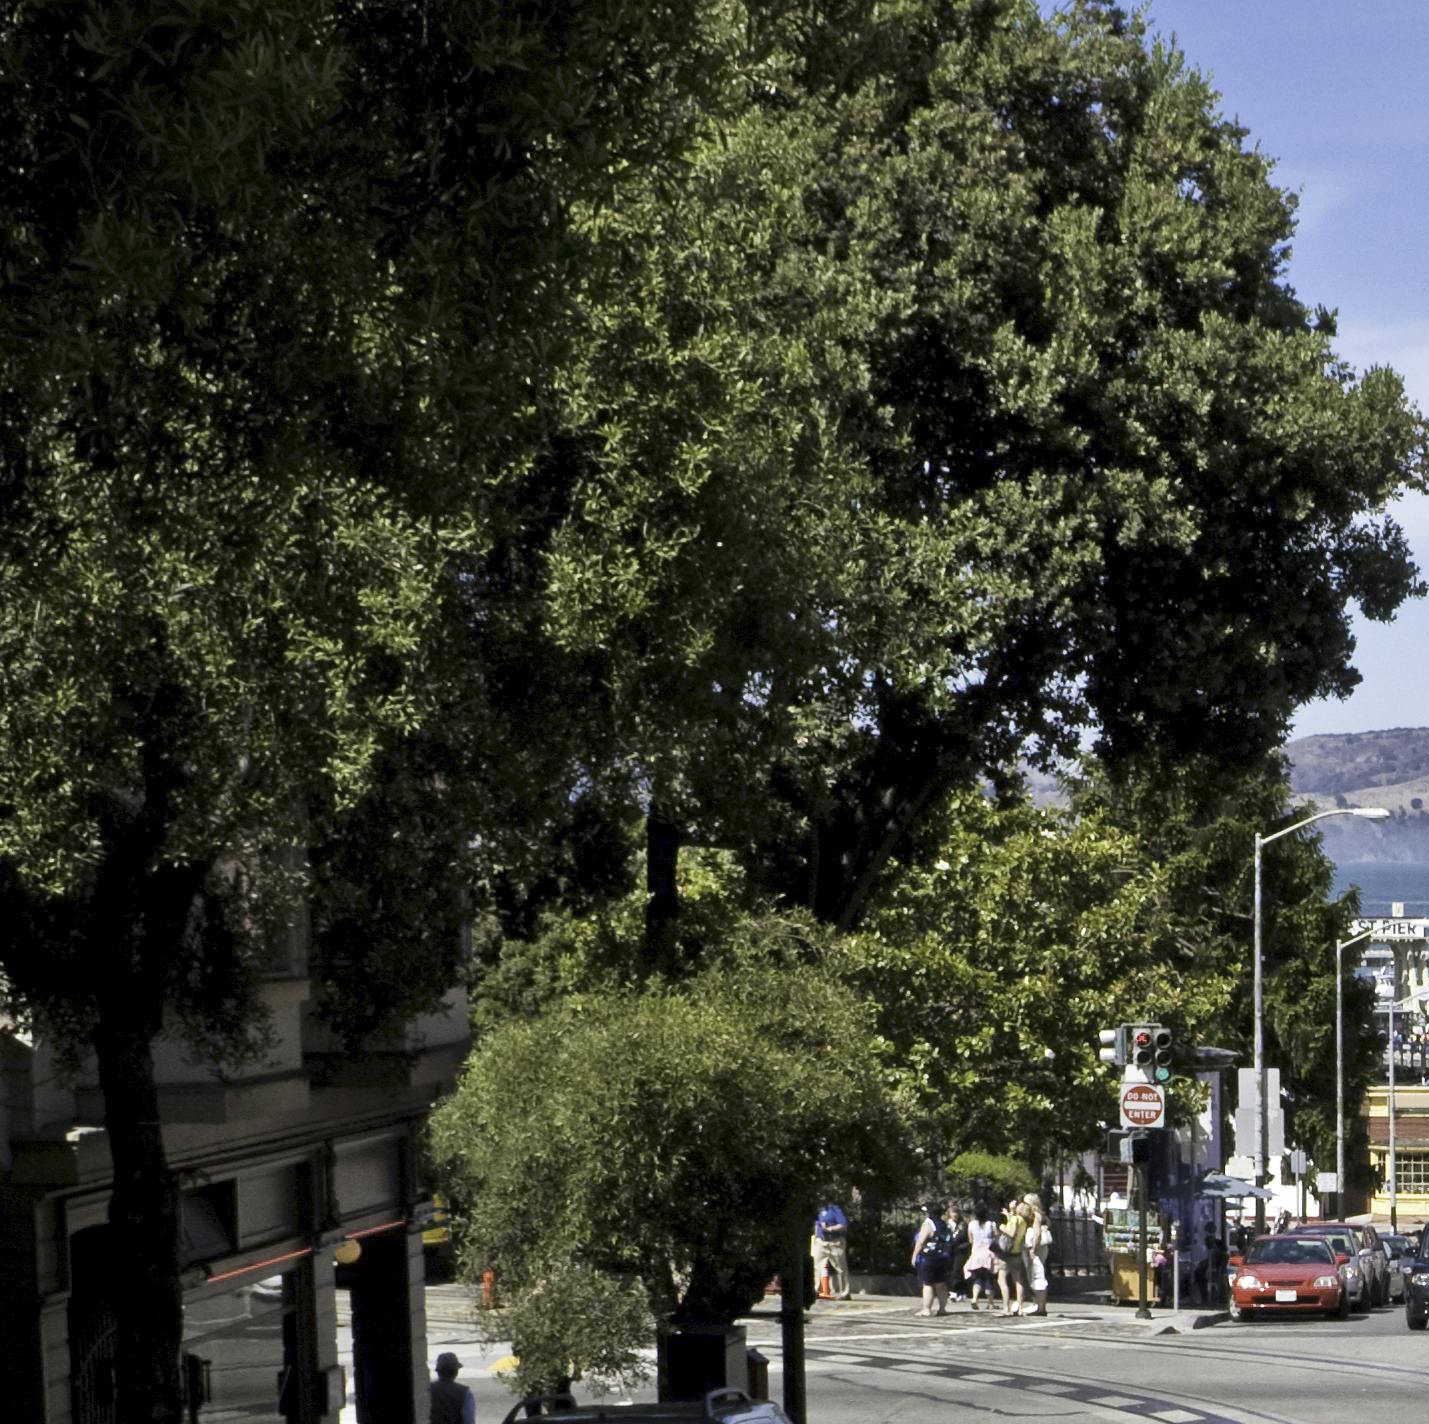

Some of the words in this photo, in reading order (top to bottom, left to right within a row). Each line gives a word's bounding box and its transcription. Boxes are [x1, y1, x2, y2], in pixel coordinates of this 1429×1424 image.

[1382, 919, 1417, 935] PIER
[1127, 1092, 1139, 1100] DO
[1141, 1092, 1158, 1101] NOT
[1128, 1110, 1157, 1119] ENTER
